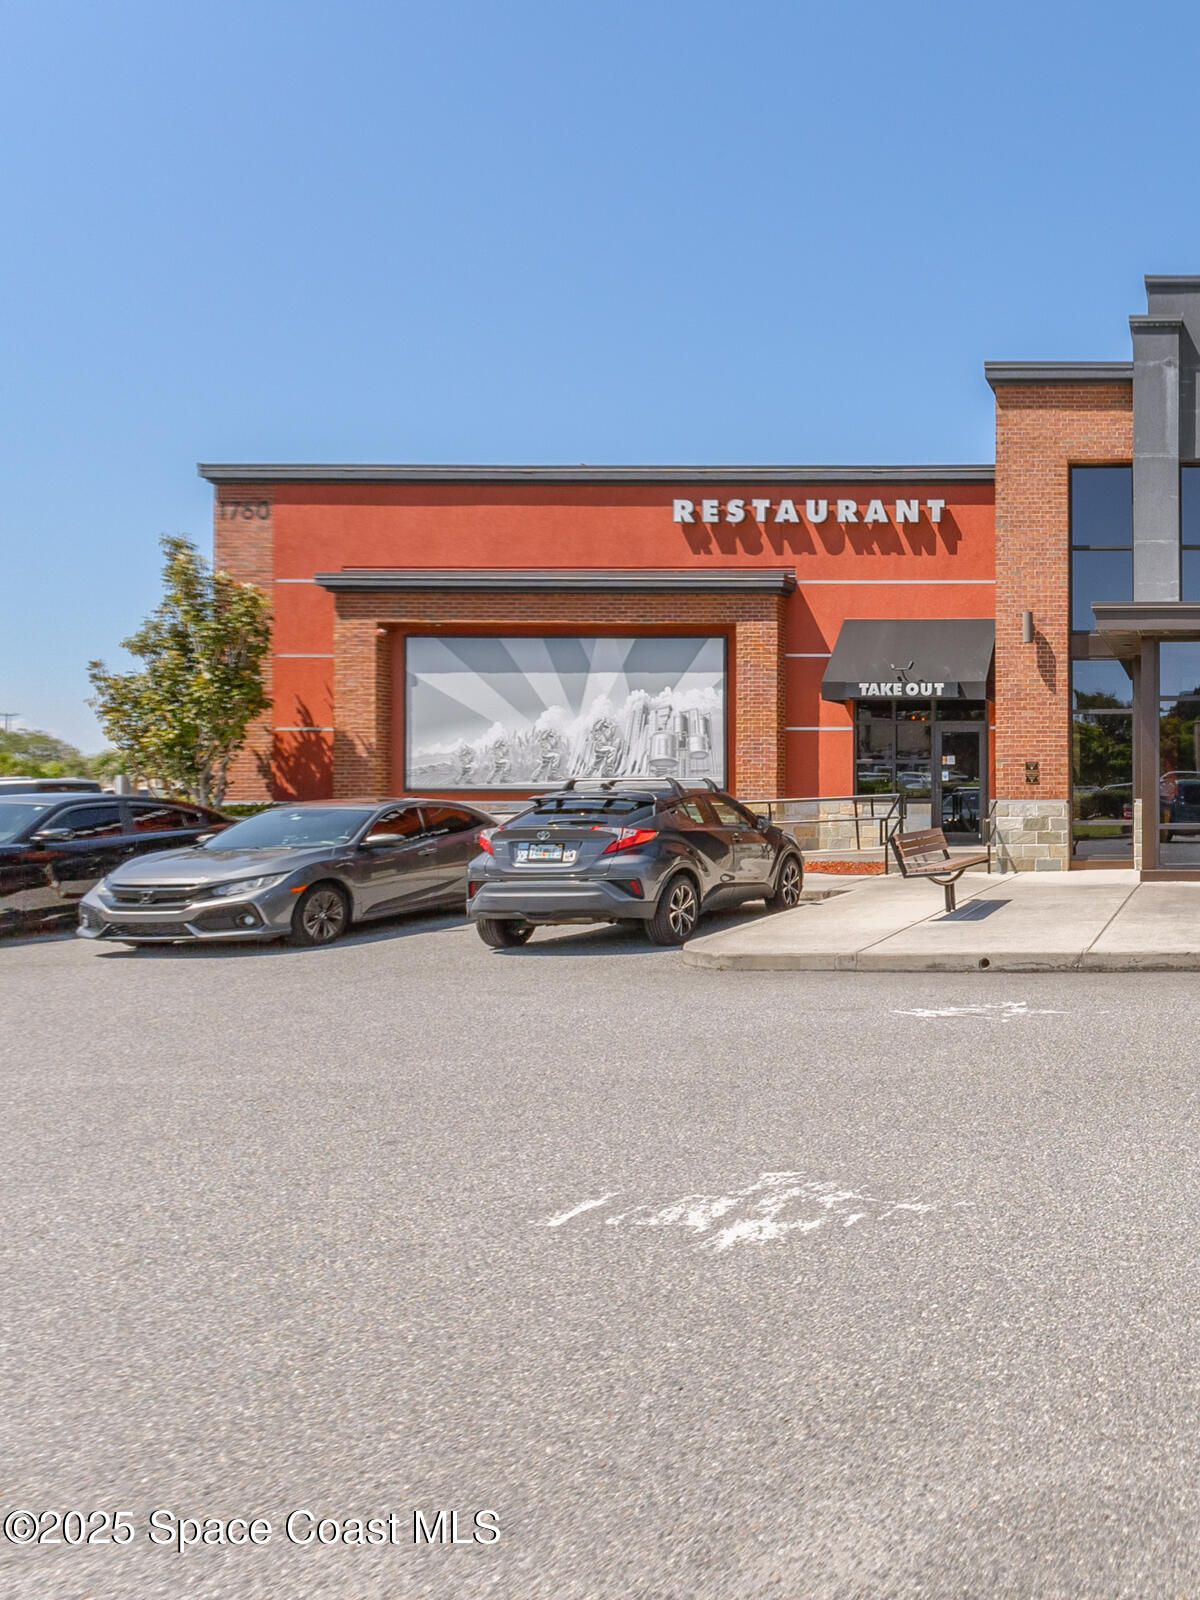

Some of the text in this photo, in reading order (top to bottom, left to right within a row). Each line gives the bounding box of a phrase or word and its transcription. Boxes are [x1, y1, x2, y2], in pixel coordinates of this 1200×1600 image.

[672, 498, 946, 524] RESTAURANT
[858, 682, 945, 696] TAKE OUT
